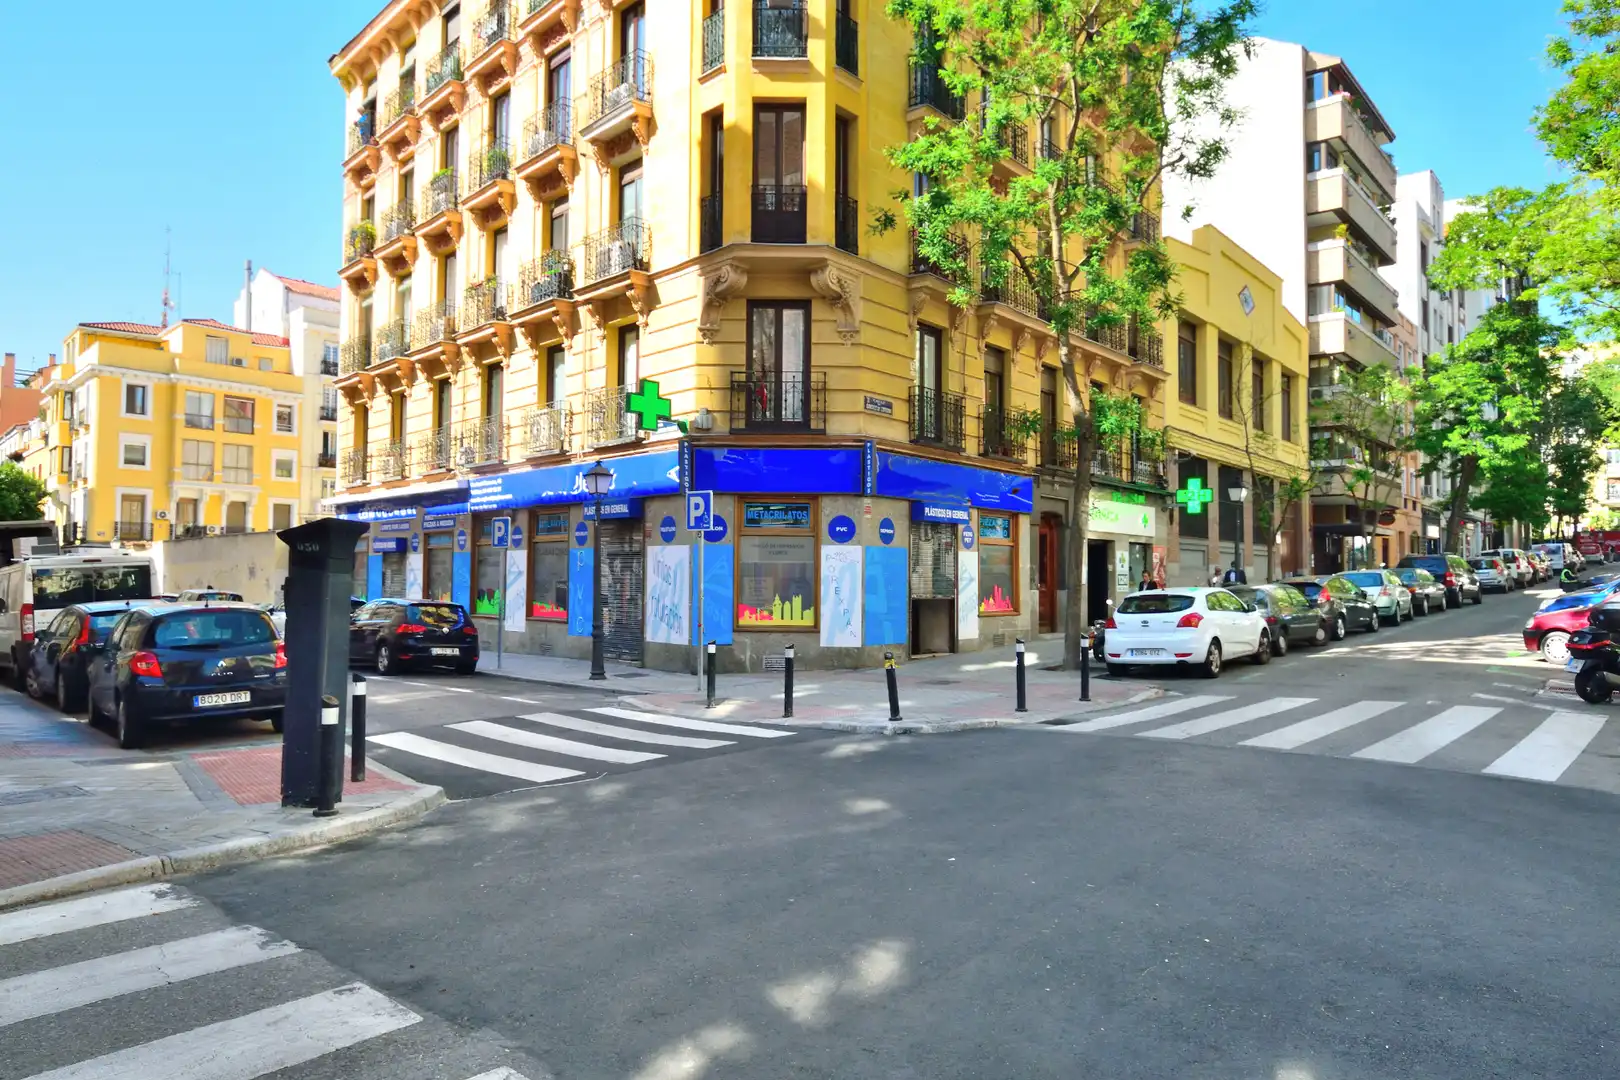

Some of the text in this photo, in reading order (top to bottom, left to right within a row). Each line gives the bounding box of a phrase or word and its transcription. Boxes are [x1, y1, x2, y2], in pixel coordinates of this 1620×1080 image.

[610, 504, 629, 514] GENERAL
[689, 496, 705, 526] P
[747, 510, 808, 520] METACRILATOS
[924, 505, 946, 518] PLÁSTICOS
[952, 510, 969, 520] GENERAL
[494, 521, 505, 545] P
[200, 691, 248, 704] 8020 DRT
